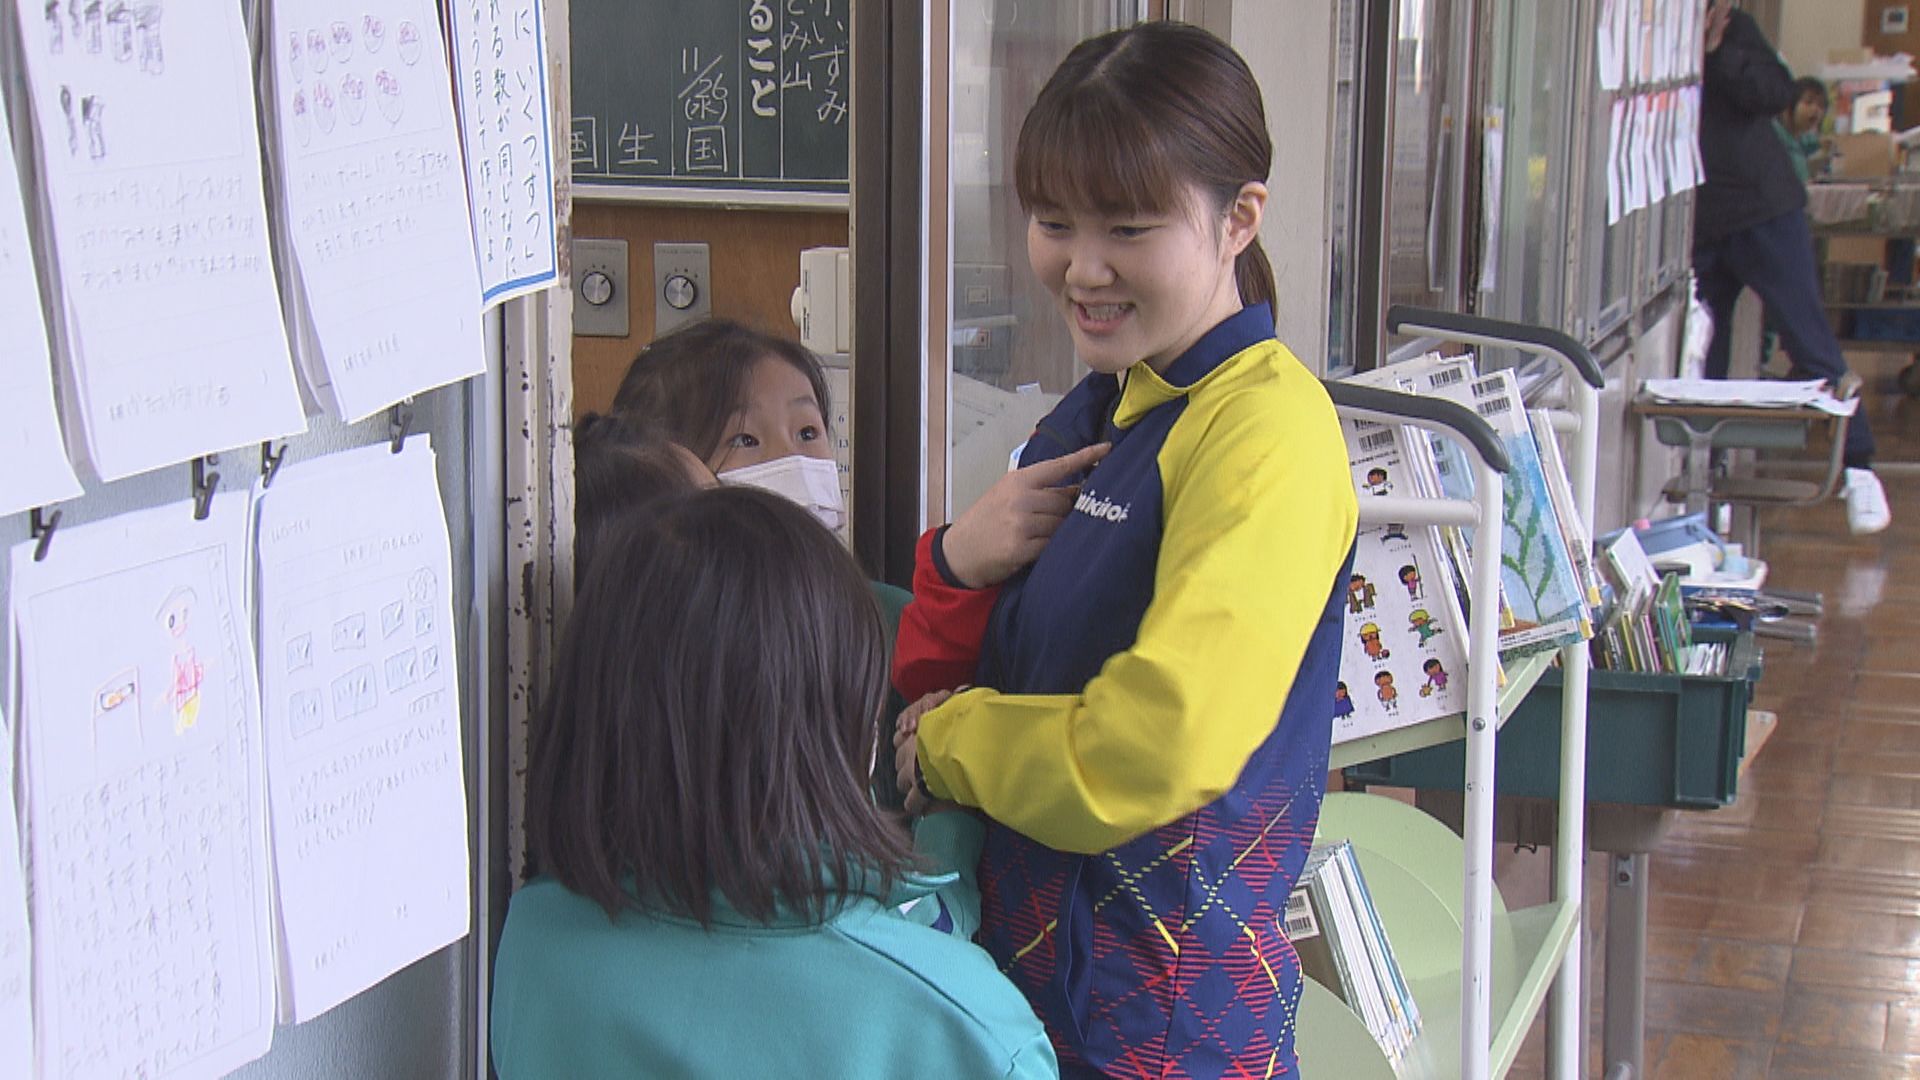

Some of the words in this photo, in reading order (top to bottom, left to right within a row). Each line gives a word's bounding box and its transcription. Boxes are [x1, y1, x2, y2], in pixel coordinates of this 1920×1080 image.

[747, 0, 777, 116] ること
[618, 122, 658, 165] 生
[685, 125, 728, 172] 国
[838, 415, 845, 424] 6
[838, 438, 849, 449] 13
